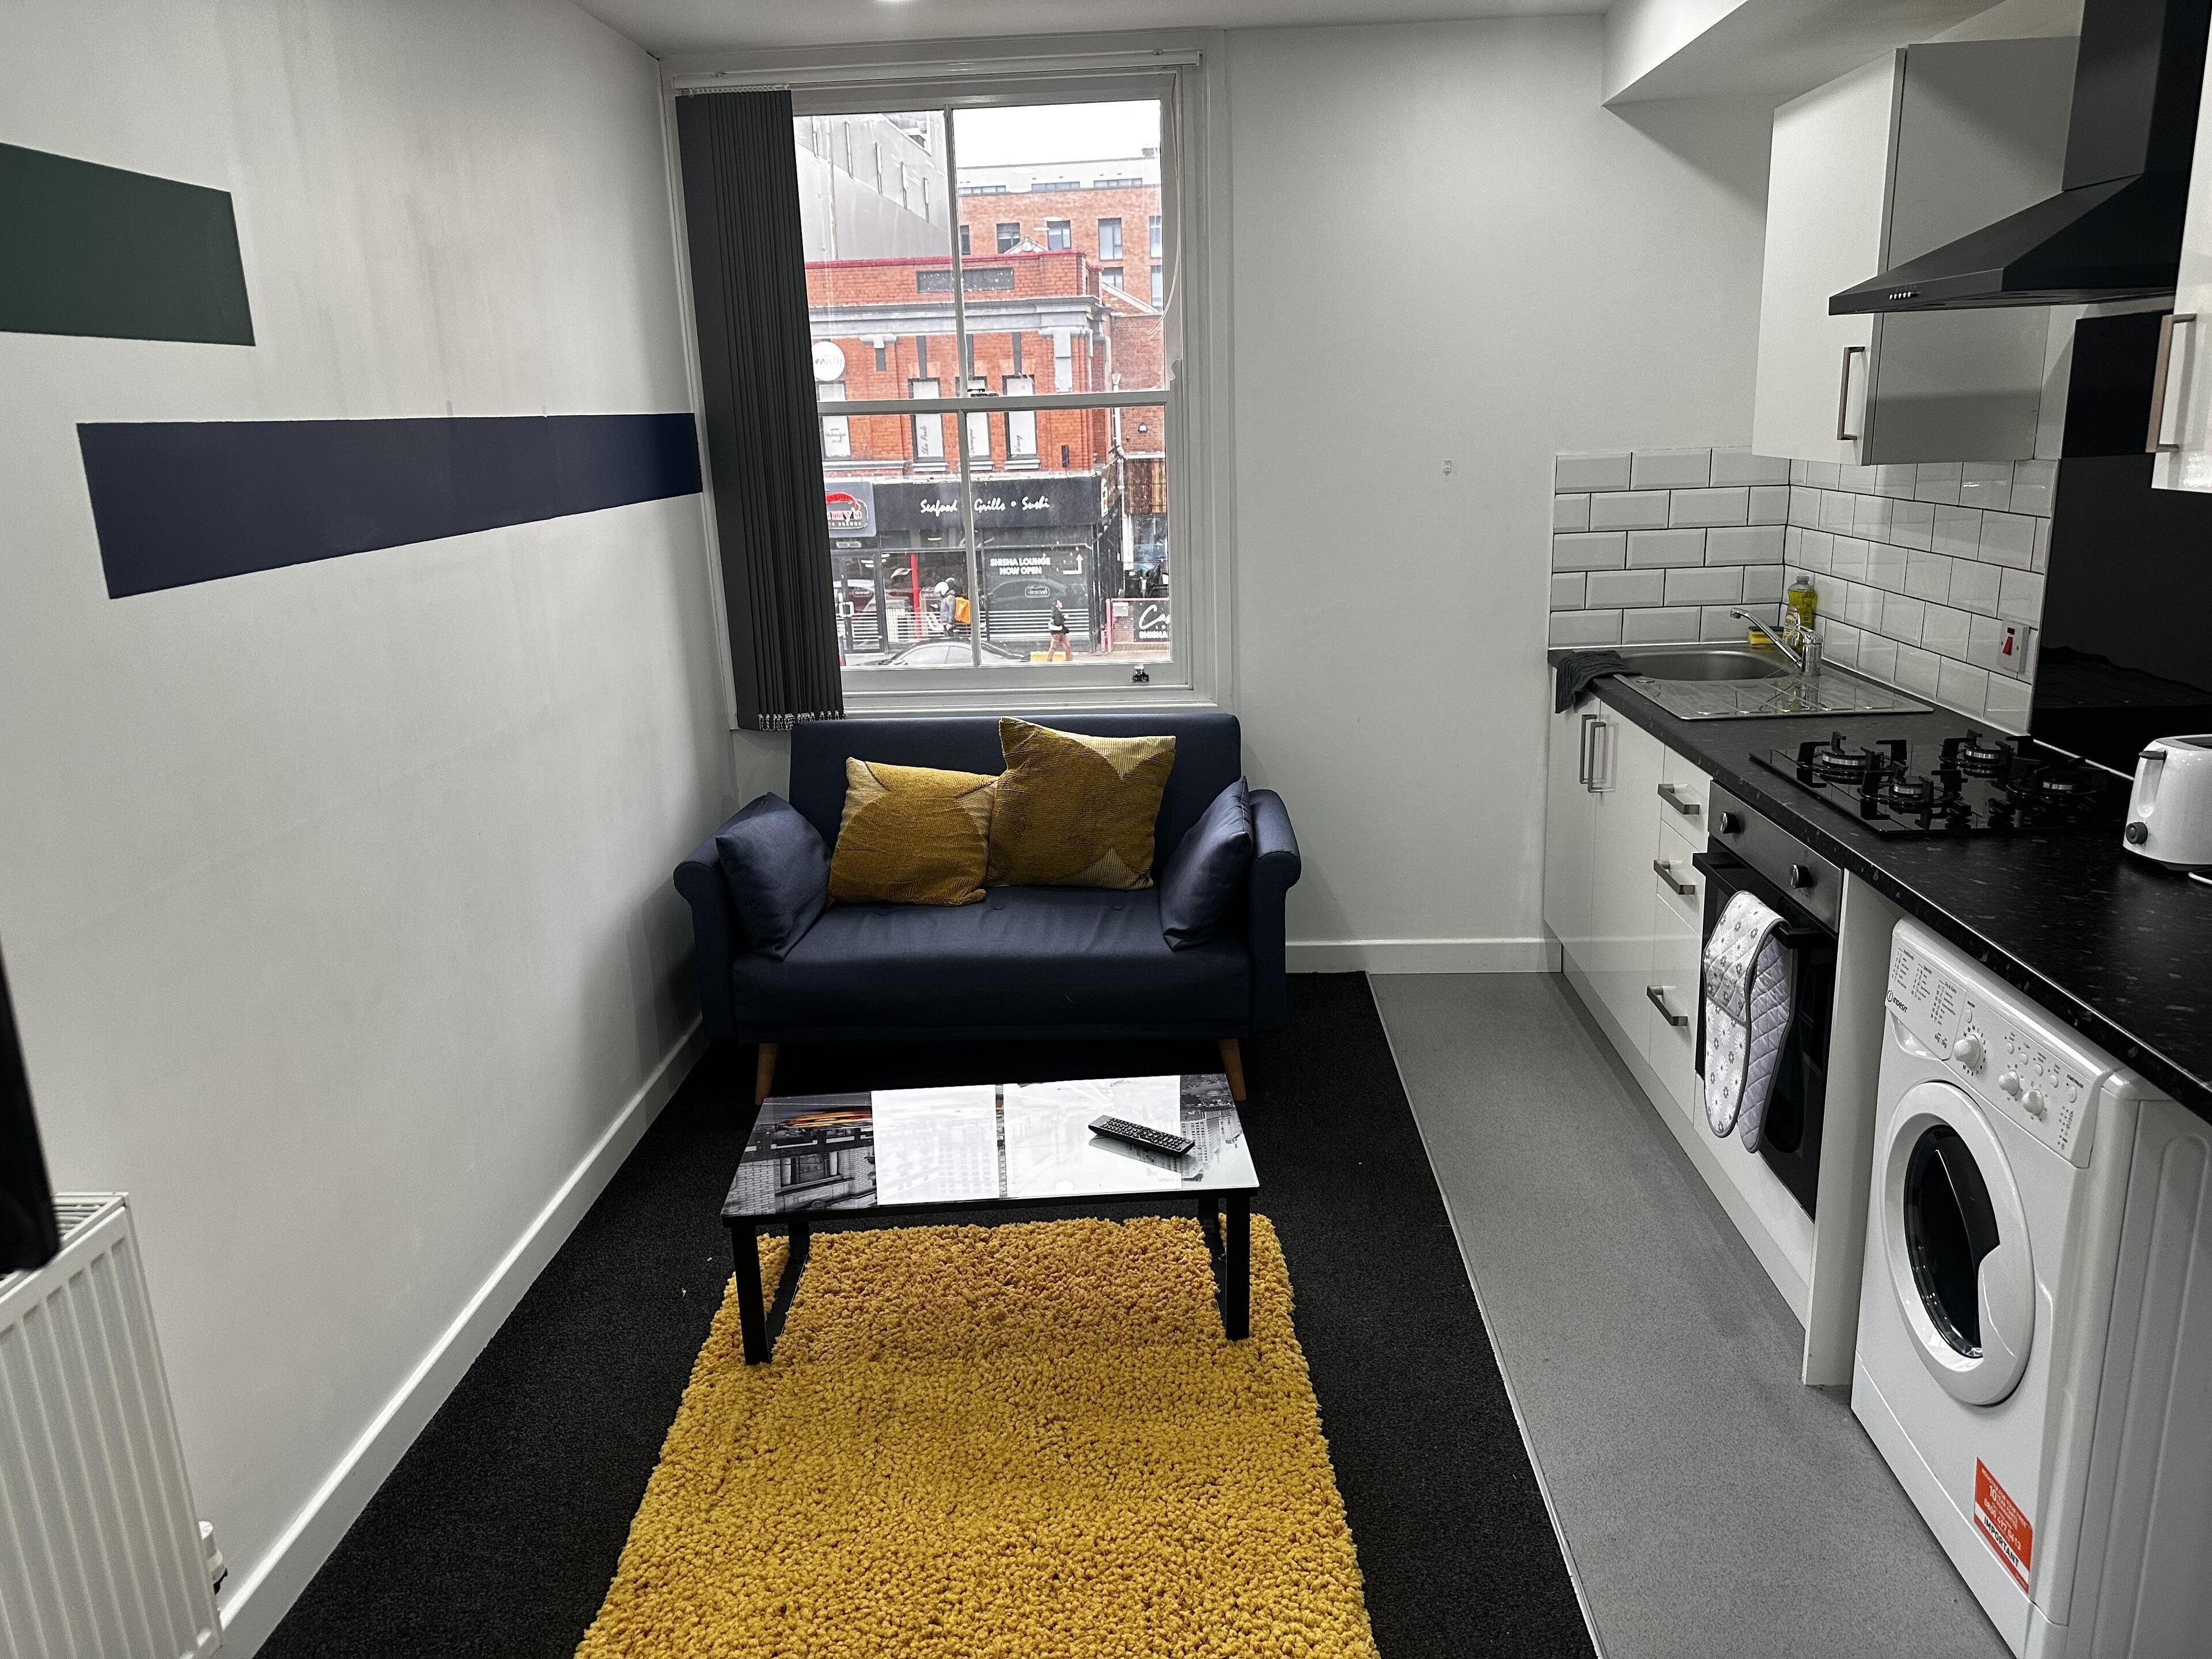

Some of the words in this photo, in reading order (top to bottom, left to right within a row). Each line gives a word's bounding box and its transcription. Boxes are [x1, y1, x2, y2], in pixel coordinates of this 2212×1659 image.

[920, 499, 958, 517] Seafood
[974, 497, 1006, 513] Grills
[1022, 495, 1050, 510] Sushi
[990, 558, 1018, 566] SHISHA
[1018, 557, 1051, 566] LOUNGE
[999, 566, 1020, 575] NOW
[1020, 566, 1042, 574] OPEN
[1989, 1484, 1996, 1502] 10
[1984, 1516, 2018, 1568] IMPORTANT
